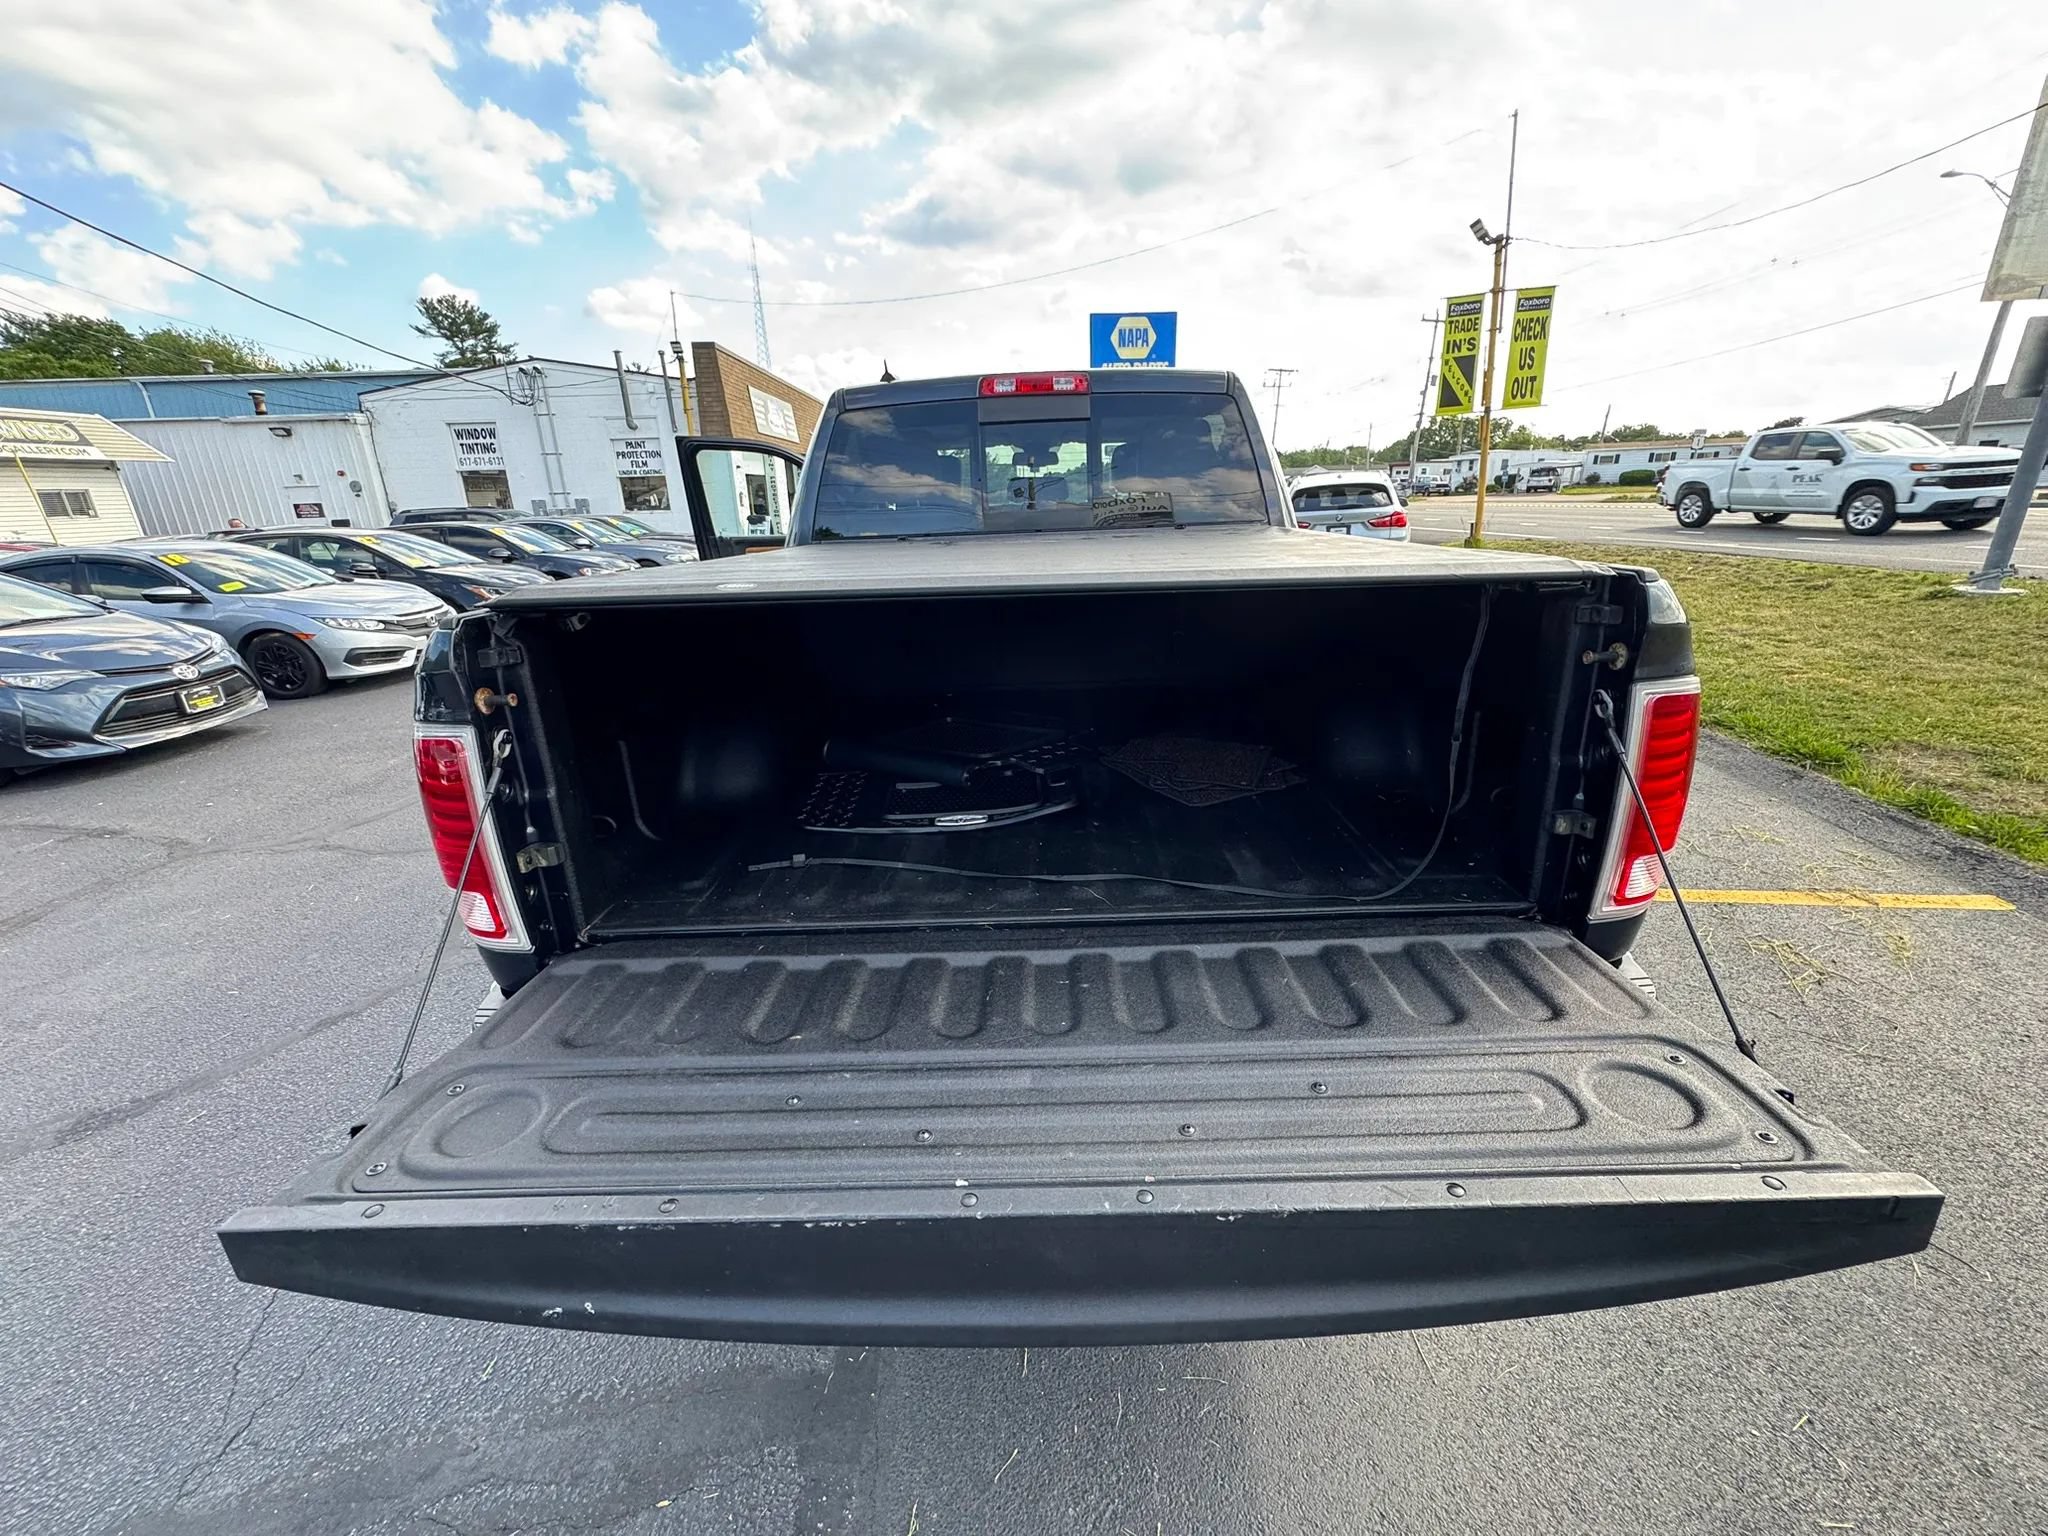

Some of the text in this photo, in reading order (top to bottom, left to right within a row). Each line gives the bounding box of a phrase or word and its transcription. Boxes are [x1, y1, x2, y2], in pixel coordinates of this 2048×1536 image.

[1450, 302, 1481, 312] Foxboro
[1519, 298, 1551, 306] Foxboro
[1448, 317, 1479, 335] TRADE
[1514, 316, 1548, 342] CHECK
[1118, 327, 1149, 348] NAPA
[1446, 337, 1477, 354] IN'S
[1519, 346, 1535, 370] US
[1445, 359, 1472, 403] WELCOME
[1511, 376, 1537, 400] OUT
[453, 427, 496, 441] WINDOW
[459, 442, 497, 455] TINTING
[625, 440, 647, 450] PAINT
[616, 450, 662, 460] PROTECTION
[630, 460, 649, 469] FILM
